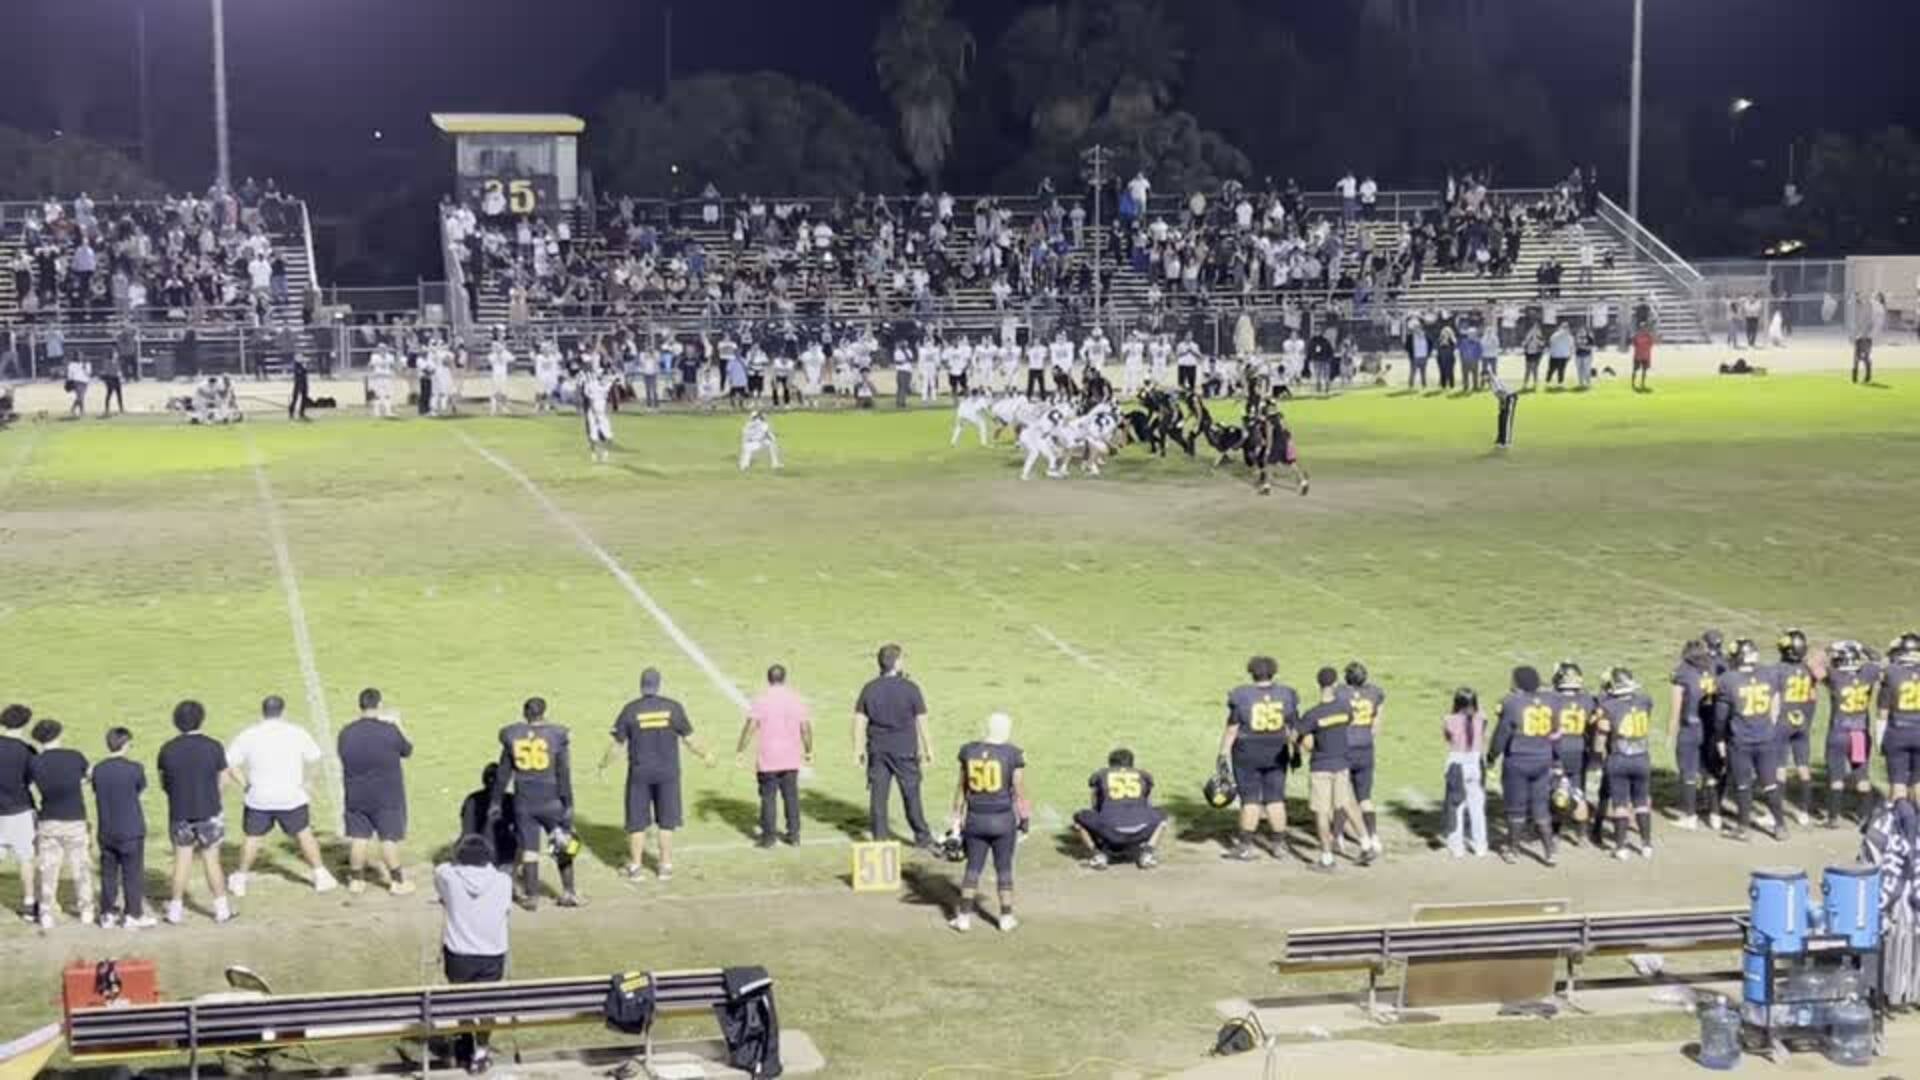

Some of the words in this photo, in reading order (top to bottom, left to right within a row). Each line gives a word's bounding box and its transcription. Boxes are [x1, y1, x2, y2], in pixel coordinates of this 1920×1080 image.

[1738, 682, 1772, 716] 75
[1839, 683, 1872, 713] 35
[1250, 701, 1283, 732] 65
[513, 736, 549, 771] 56
[967, 758, 1002, 792] 50
[1106, 771, 1142, 800] 55
[859, 848, 897, 882] 50
